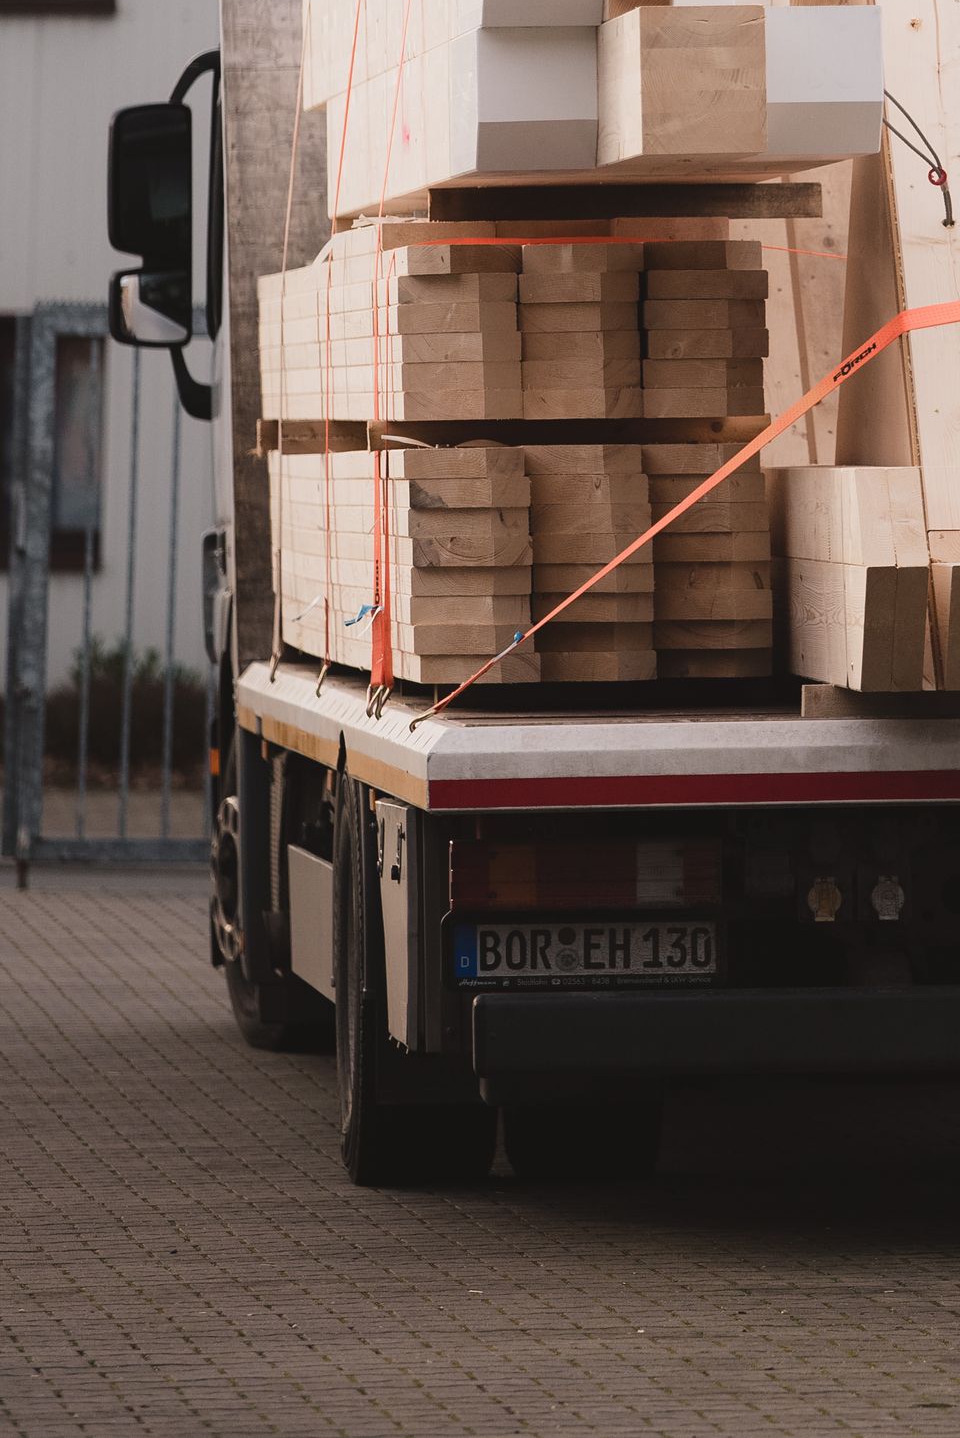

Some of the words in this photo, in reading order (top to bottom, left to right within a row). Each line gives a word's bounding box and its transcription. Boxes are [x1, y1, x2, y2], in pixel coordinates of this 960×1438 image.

[460, 956, 469, 968] D
[479, 929, 552, 971] BOR
[583, 928, 631, 970] EH
[642, 927, 712, 967] 130
